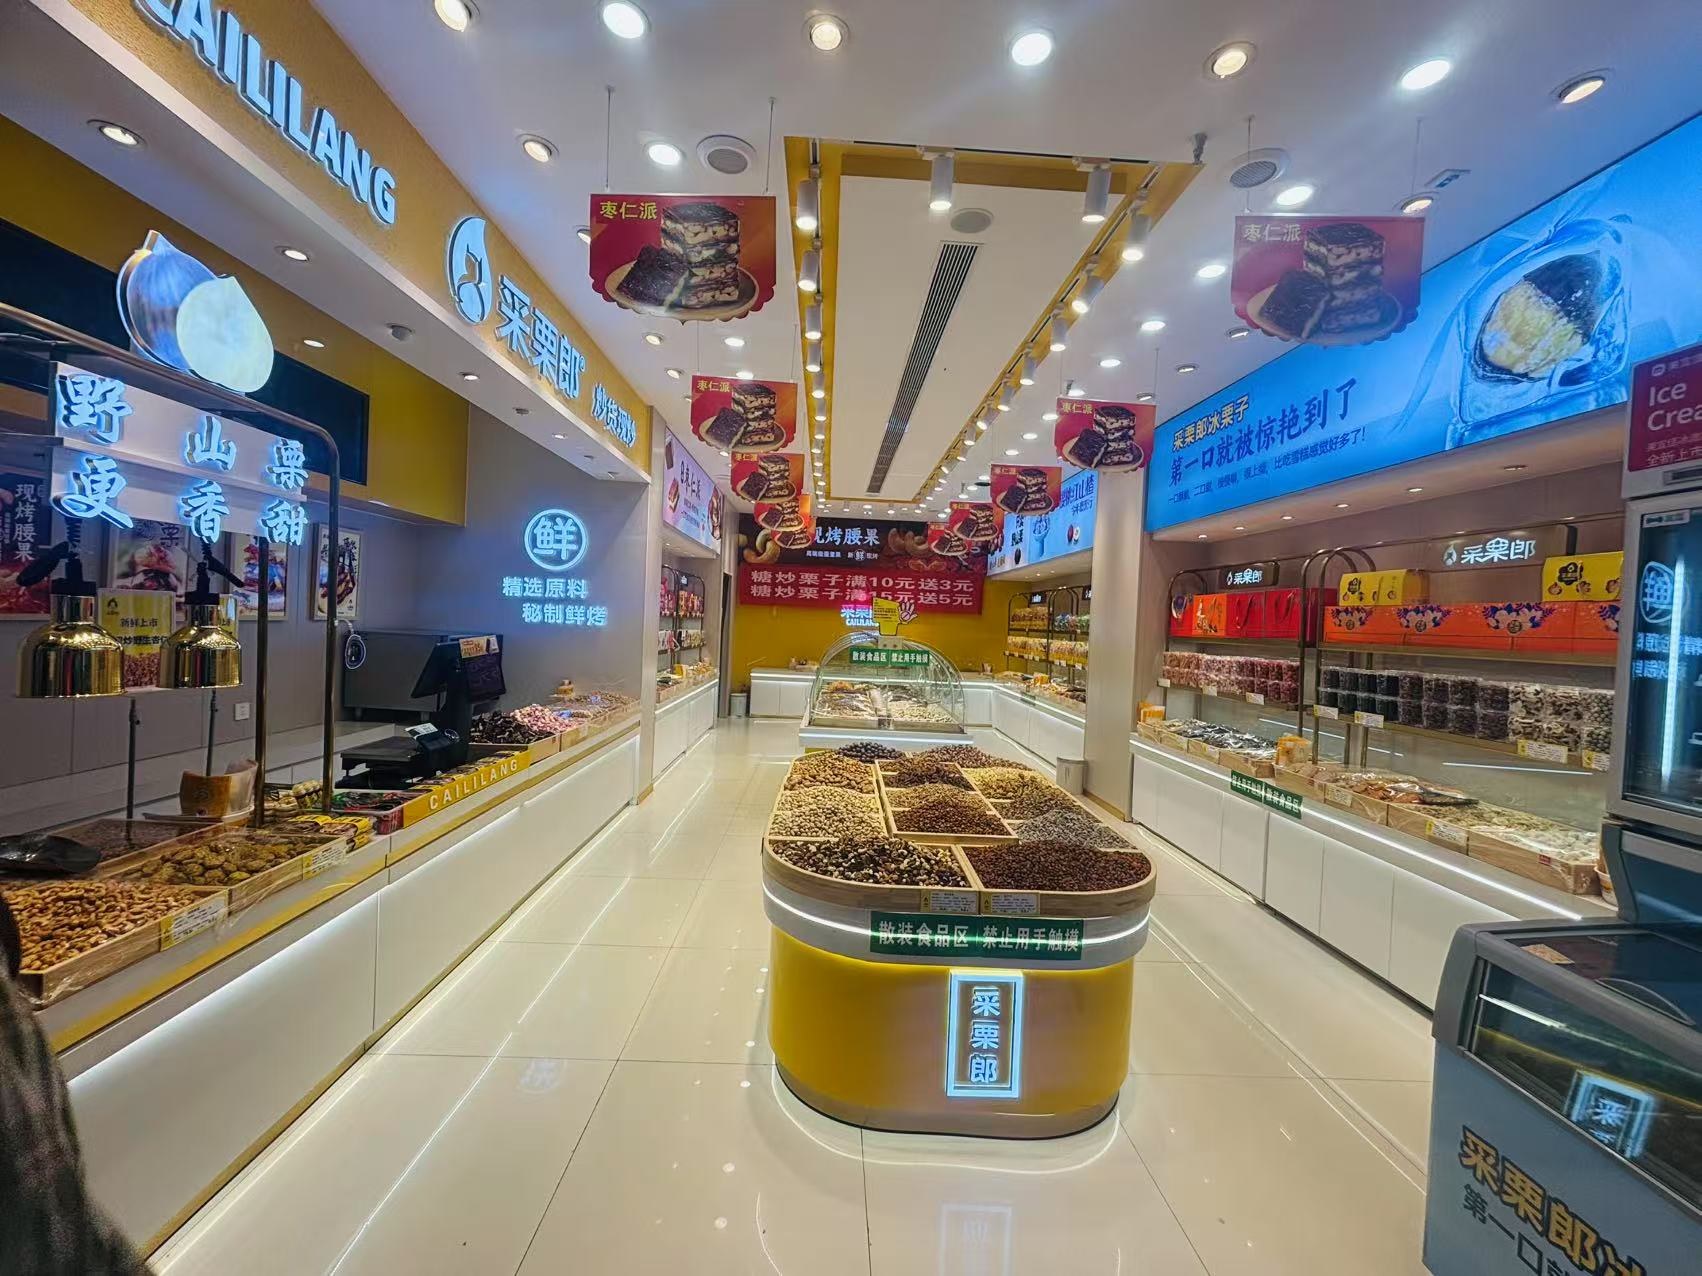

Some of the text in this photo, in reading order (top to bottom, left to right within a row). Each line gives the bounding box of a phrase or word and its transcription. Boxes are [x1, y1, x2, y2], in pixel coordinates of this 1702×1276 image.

[600, 201, 658, 219] 枣仁派
[1244, 223, 1302, 242] 枣仁派
[697, 380, 731, 393] 枣仁派
[1649, 382, 1687, 406] Ice
[1062, 402, 1093, 414] 枣仁派
[1169, 378, 1356, 487] 第一口就被惊艳到了
[1173, 395, 1250, 450] 采栗郎冰栗子
[14, 484, 37, 562] 现烤腰果
[531, 515, 580, 561] 鲜
[502, 576, 588, 598] 精选原料
[521, 602, 608, 626] 秘制鲜烤
[429, 759, 518, 811] CAILILANG
[878, 921, 1080, 952] 散装食品区 禁止用手触摸
[970, 986, 1000, 1083] 采栗郎
